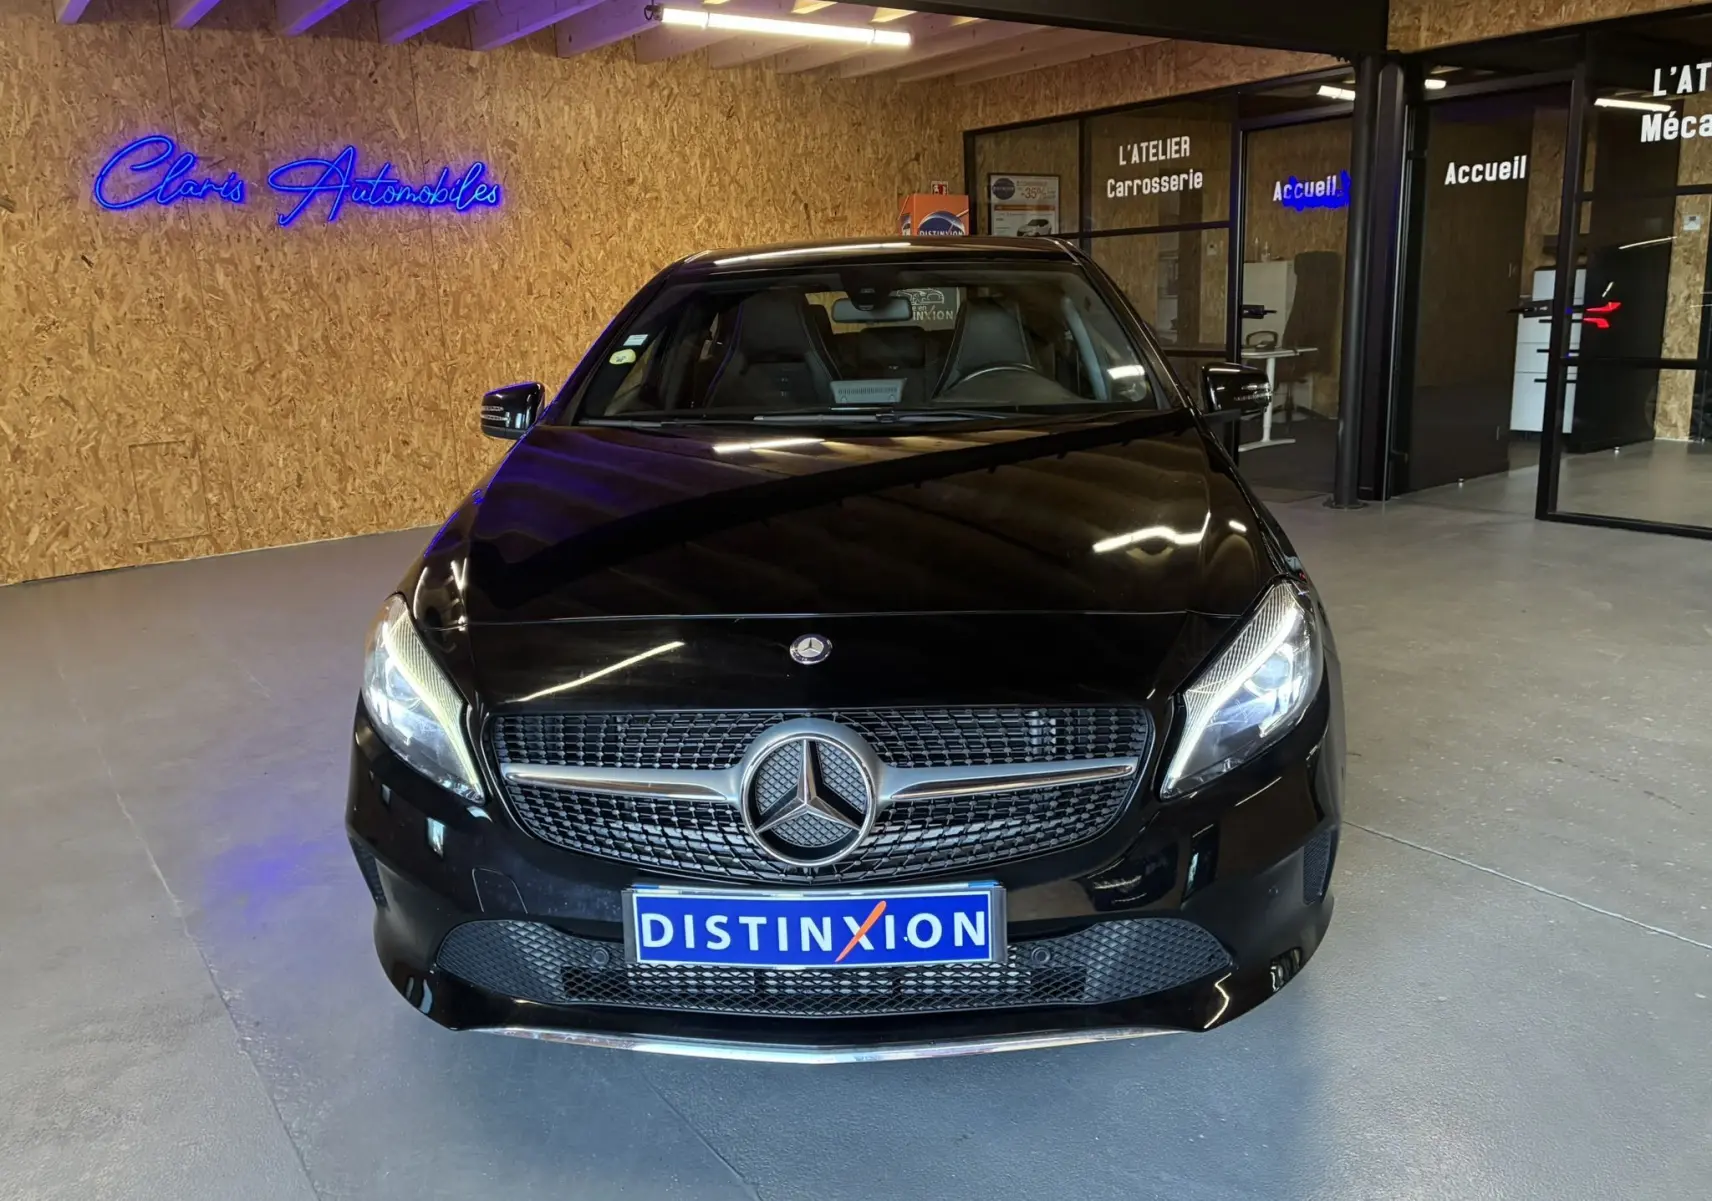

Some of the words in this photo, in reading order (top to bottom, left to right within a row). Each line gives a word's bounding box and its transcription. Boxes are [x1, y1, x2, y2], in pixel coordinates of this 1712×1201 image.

[1640, 110, 1712, 142] Méca
[1119, 135, 1190, 166] L'ATELIER
[95, 134, 244, 209] Claris
[267, 144, 500, 226] Automobiles
[1106, 168, 1203, 198] Carrosserie
[1445, 154, 1528, 186] Accueil
[1272, 174, 1338, 202] Accueil
[640, 901, 986, 962] DISTINXION
